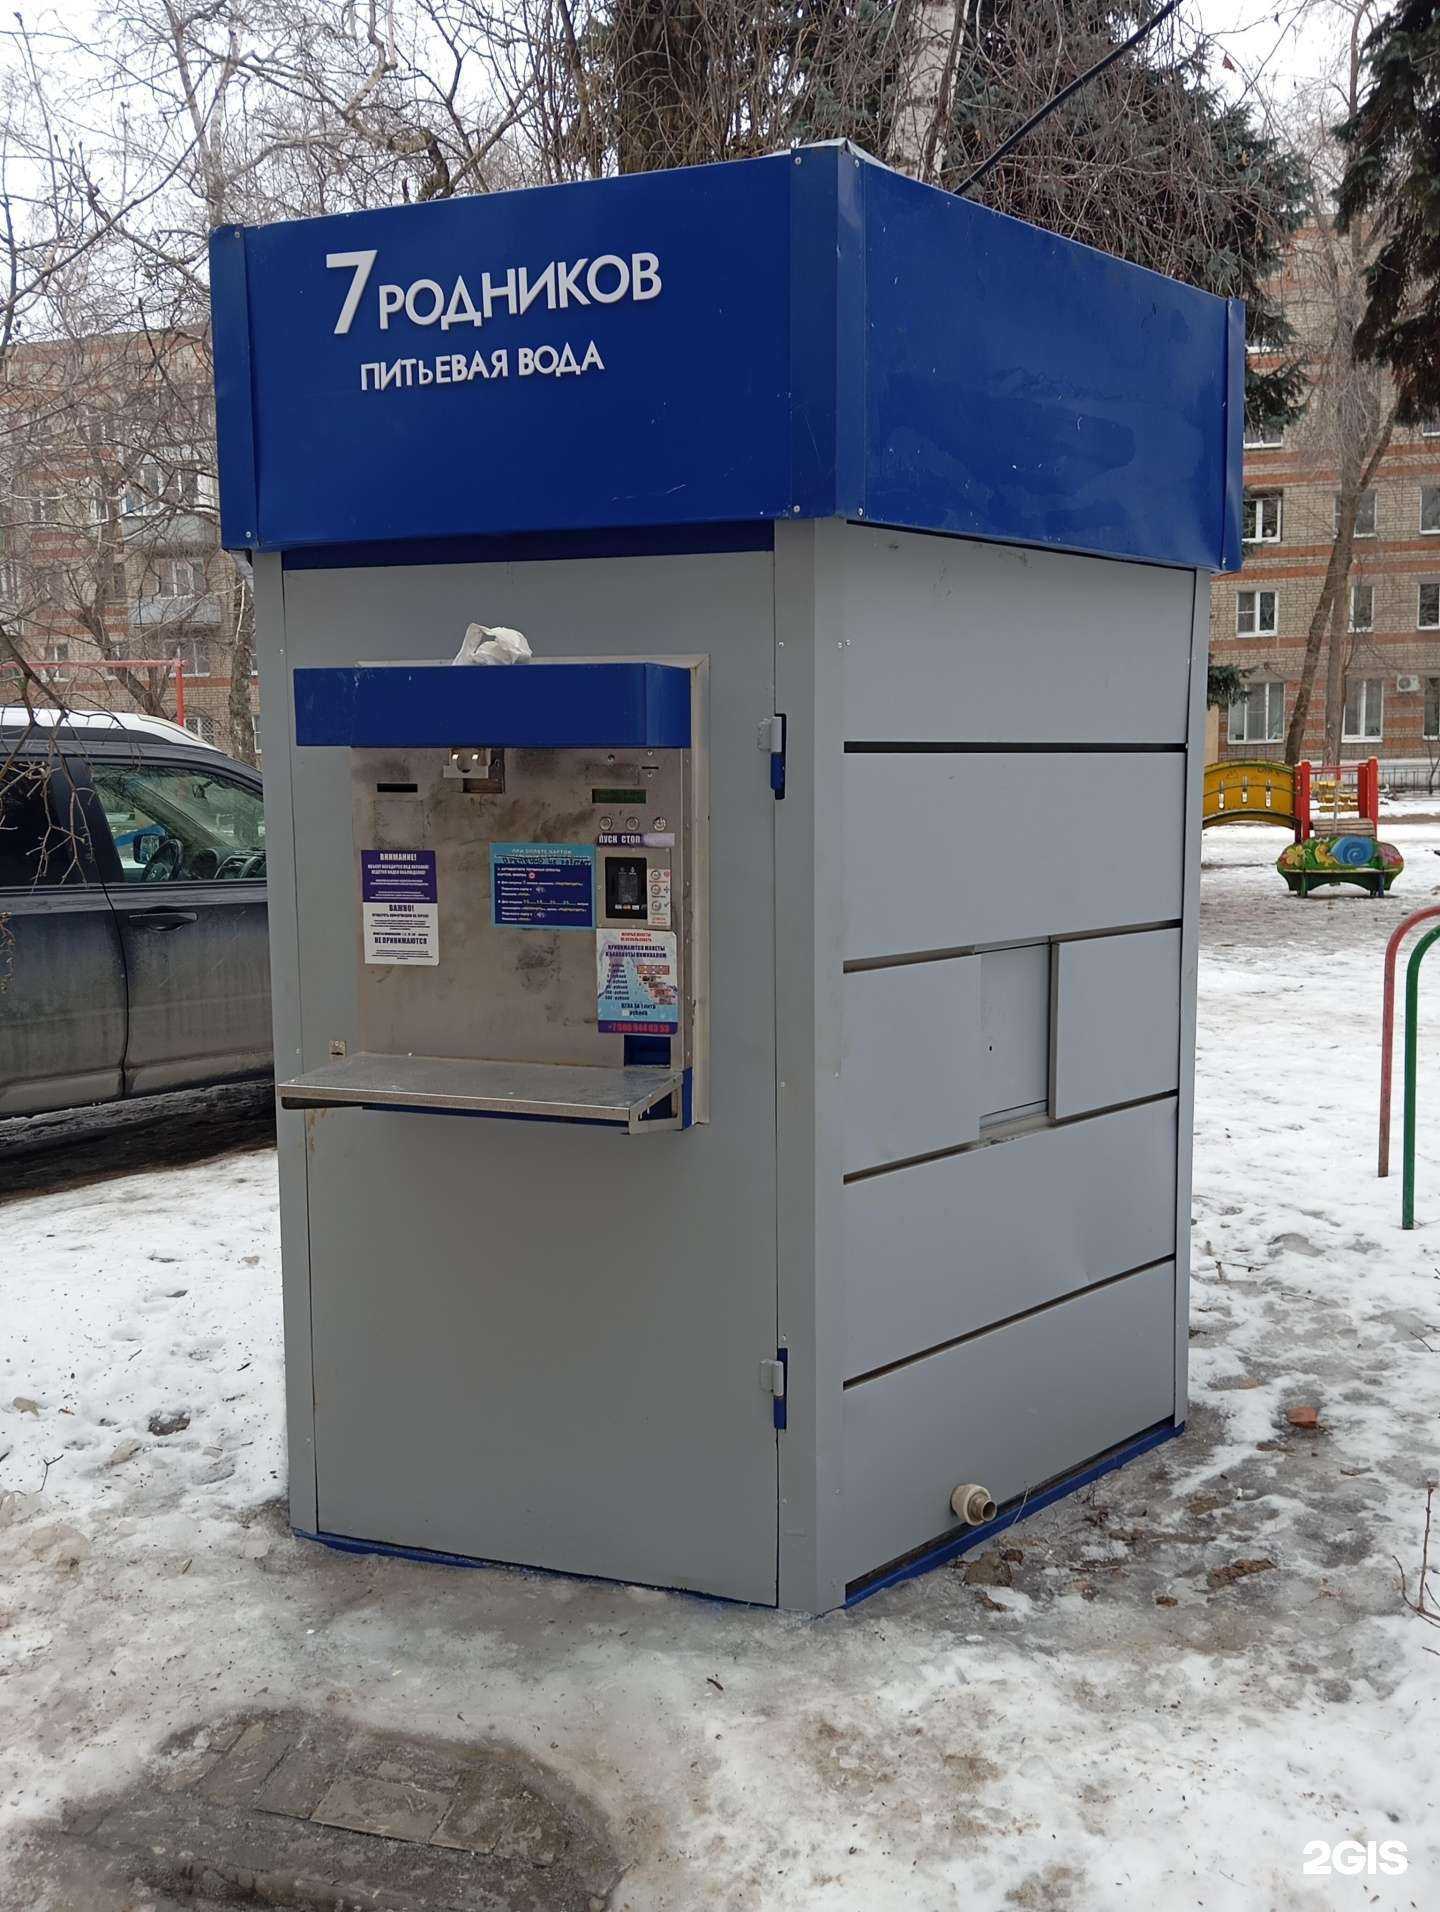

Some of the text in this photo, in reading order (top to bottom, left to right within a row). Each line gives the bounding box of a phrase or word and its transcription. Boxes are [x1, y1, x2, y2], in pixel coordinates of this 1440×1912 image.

[325, 249, 663, 335] 7 РОДНИКОВ
[360, 339, 605, 391] ПИТЬЕВАЯ ВОДА
[598, 834, 641, 844] ПУСК СТОП
